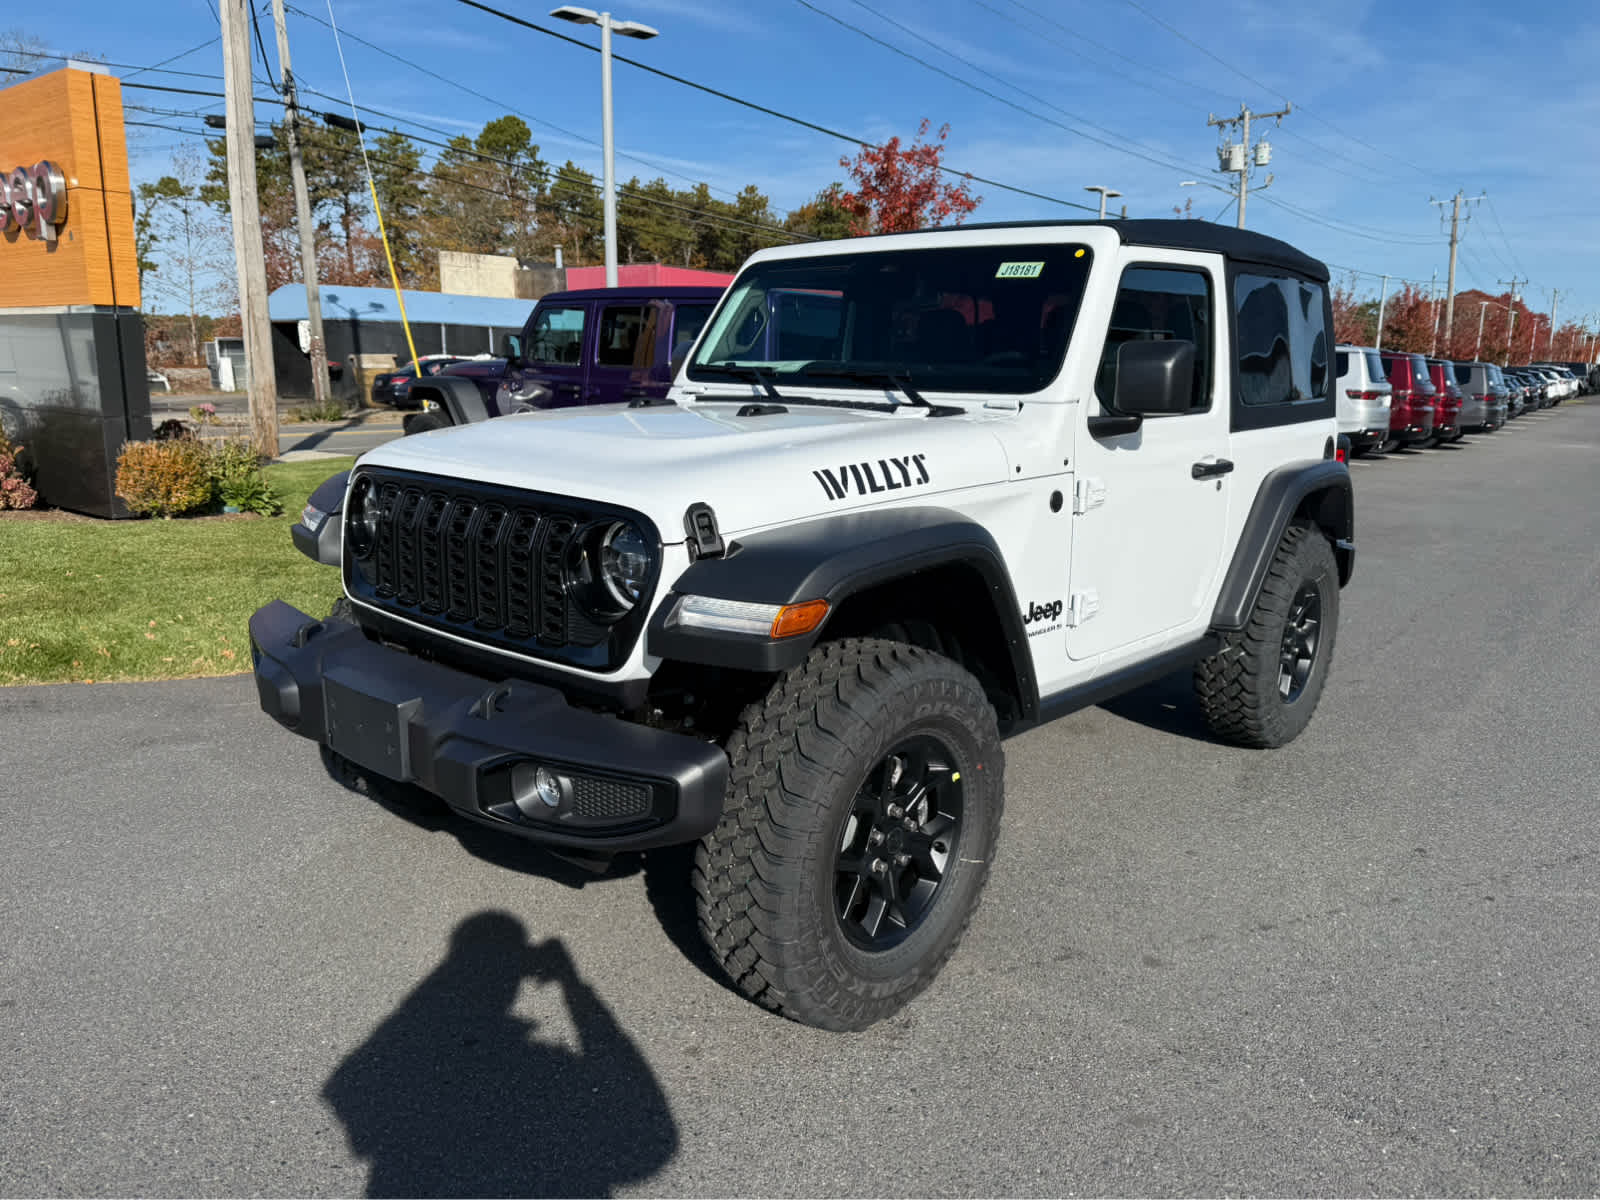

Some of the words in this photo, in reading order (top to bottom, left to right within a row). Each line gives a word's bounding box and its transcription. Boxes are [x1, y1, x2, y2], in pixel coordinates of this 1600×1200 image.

[1001, 264, 1037, 276] J18181
[812, 453, 930, 501] WILLYS
[1022, 599, 1063, 625] Jeep
